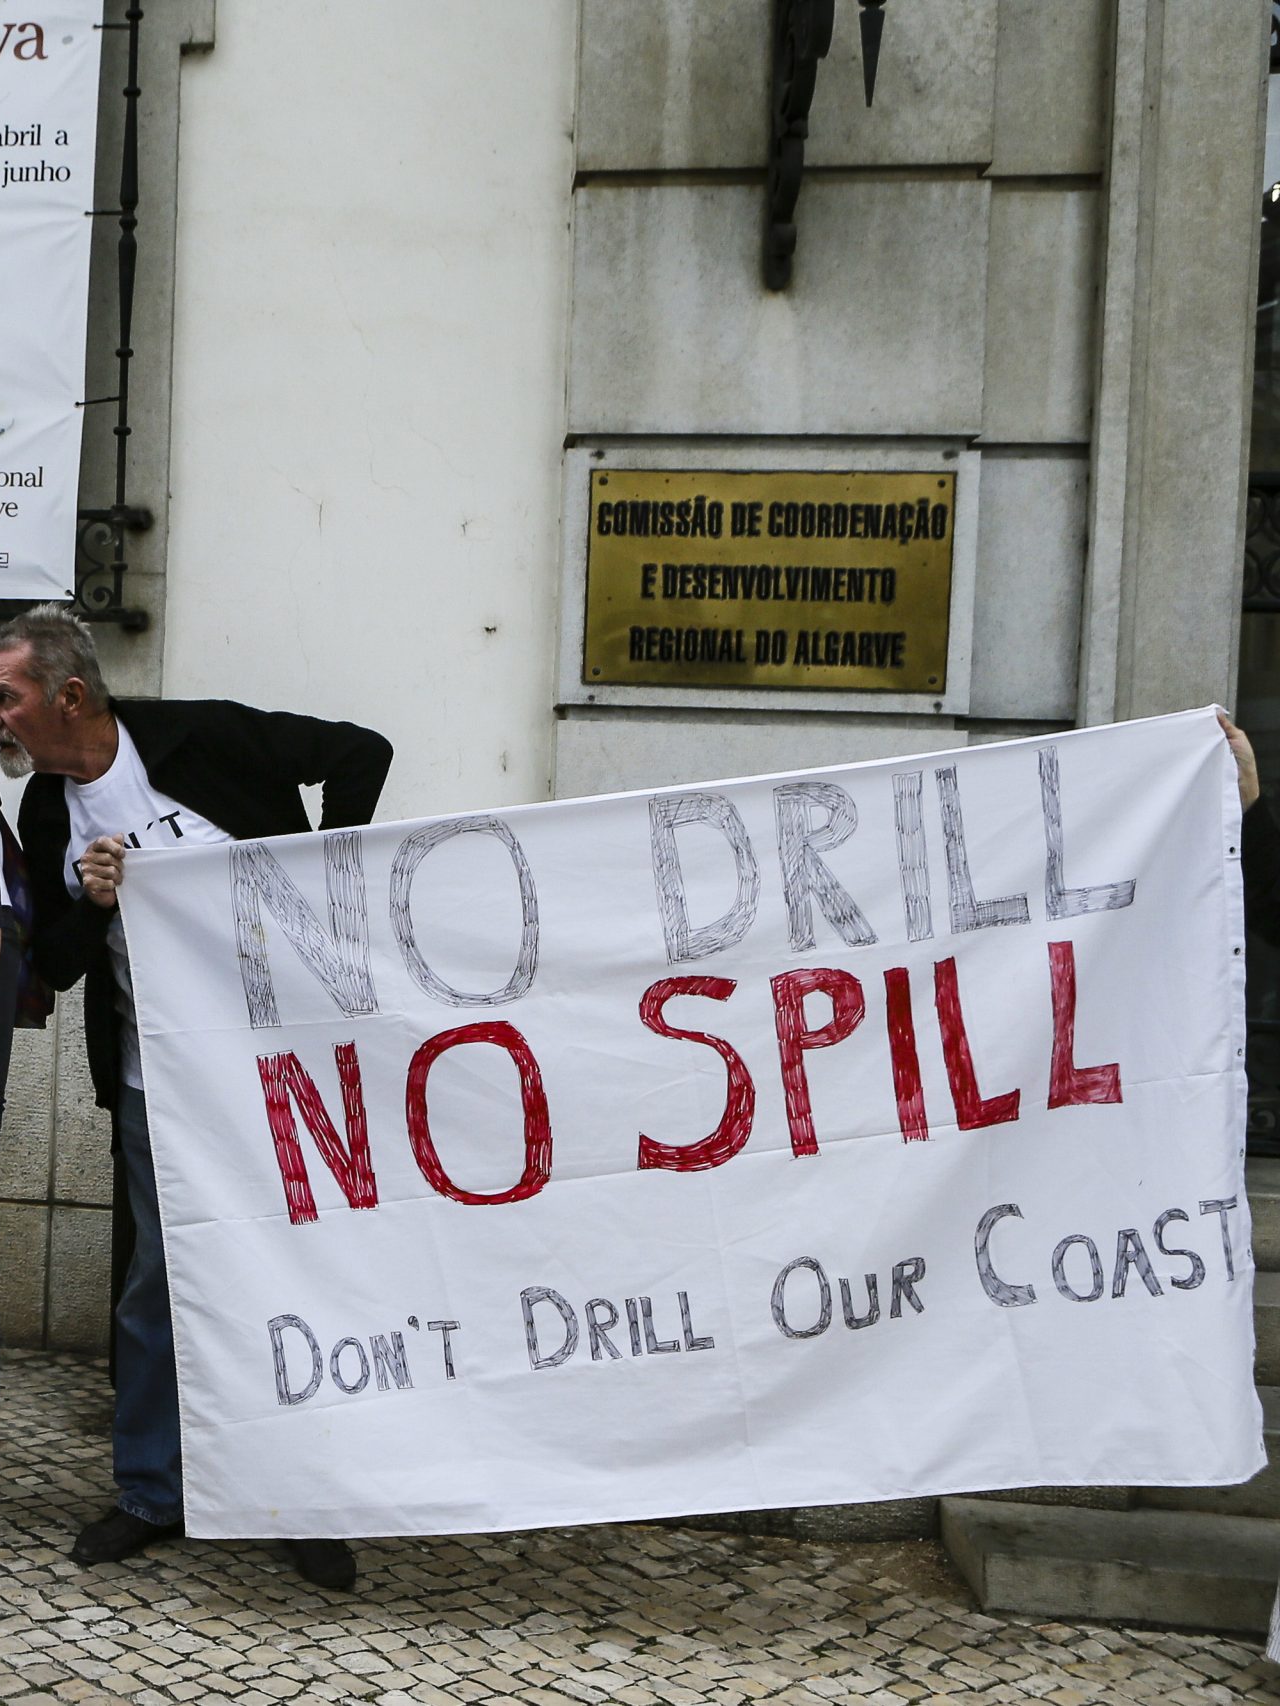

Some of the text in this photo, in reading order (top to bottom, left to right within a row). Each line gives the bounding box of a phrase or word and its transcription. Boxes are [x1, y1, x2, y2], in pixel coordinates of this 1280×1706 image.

[56, 129, 69, 147] a
[2, 160, 71, 188] junho
[597, 495, 948, 545] COMISSÃO DE COORDENAÇÃO
[641, 563, 896, 606] E DESENVOLVIMENTO
[629, 626, 906, 668] REGIONAL DO ALGARVE
[228, 745, 1137, 1029] NO DRILL
[256, 941, 1123, 1226] NO SPILL
[520, 1286, 714, 1371] DRILL
[771, 1256, 926, 1339] OUR
[974, 1195, 1238, 1308] COAST
